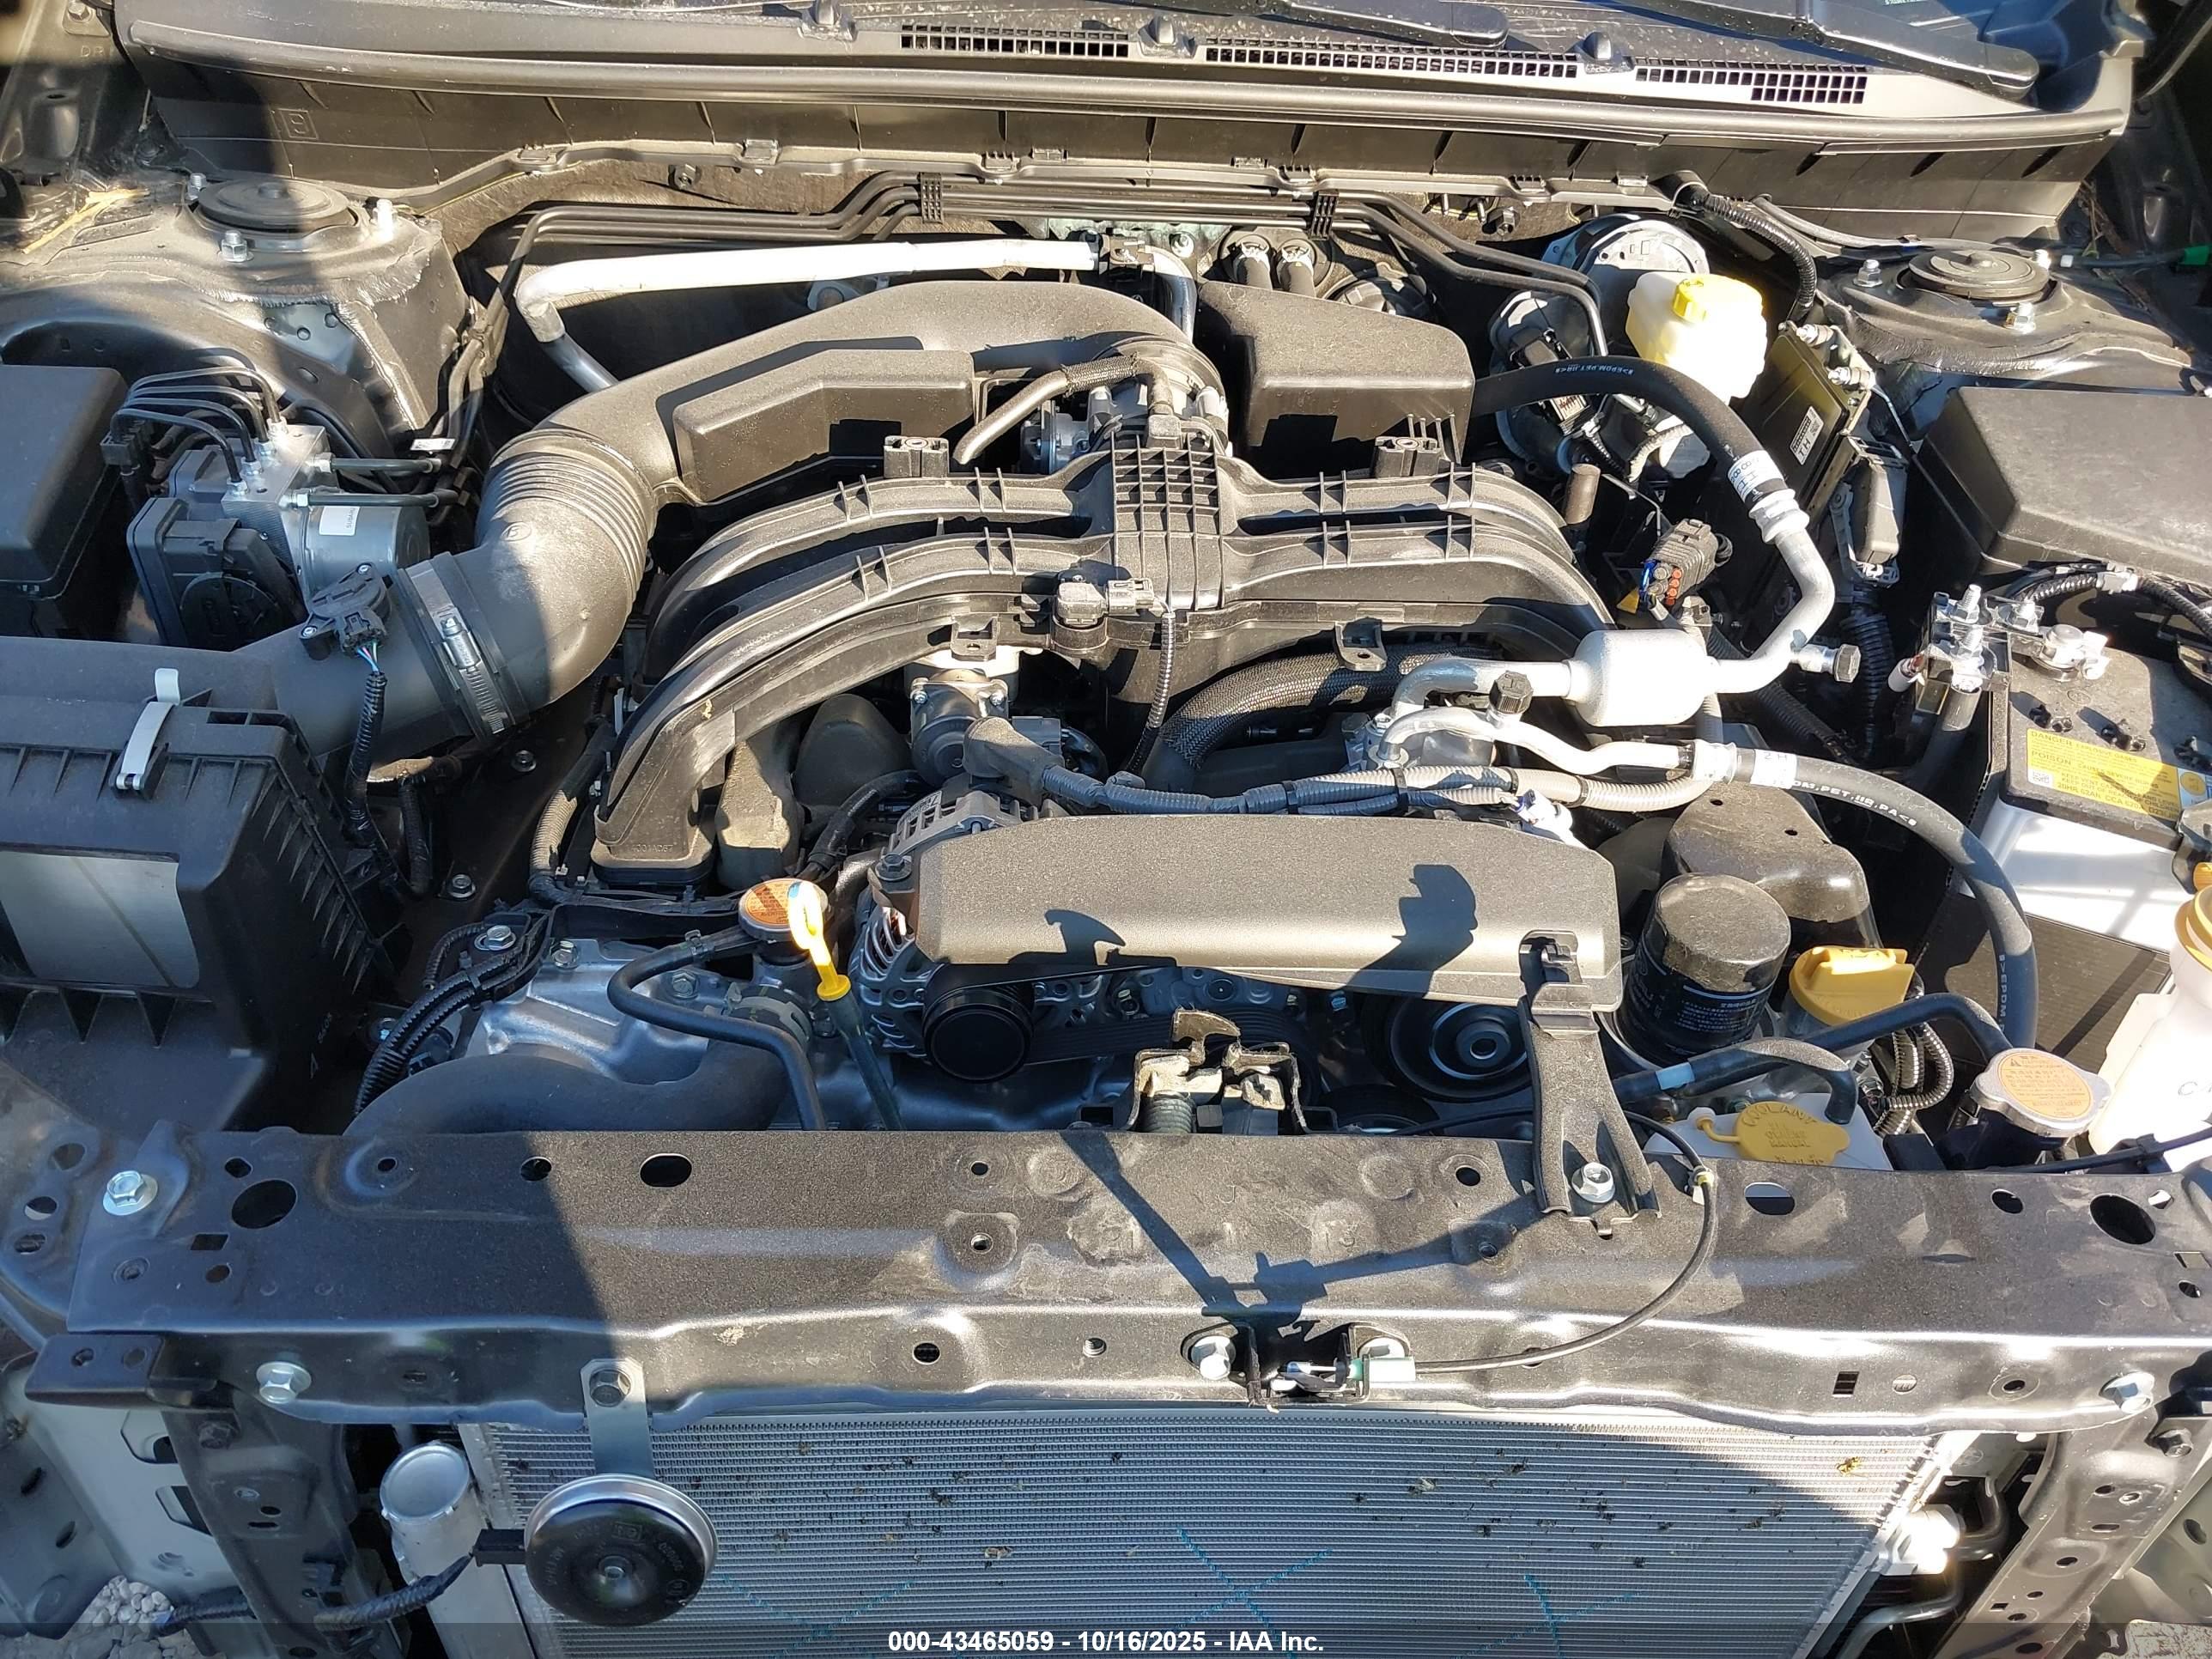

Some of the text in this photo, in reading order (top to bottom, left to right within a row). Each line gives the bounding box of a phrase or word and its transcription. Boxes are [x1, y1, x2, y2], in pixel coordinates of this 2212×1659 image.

[2031, 731, 2072, 746] DANGER
[2032, 750, 2071, 765] POISON
[1741, 1103, 1817, 1126] COOLANT
